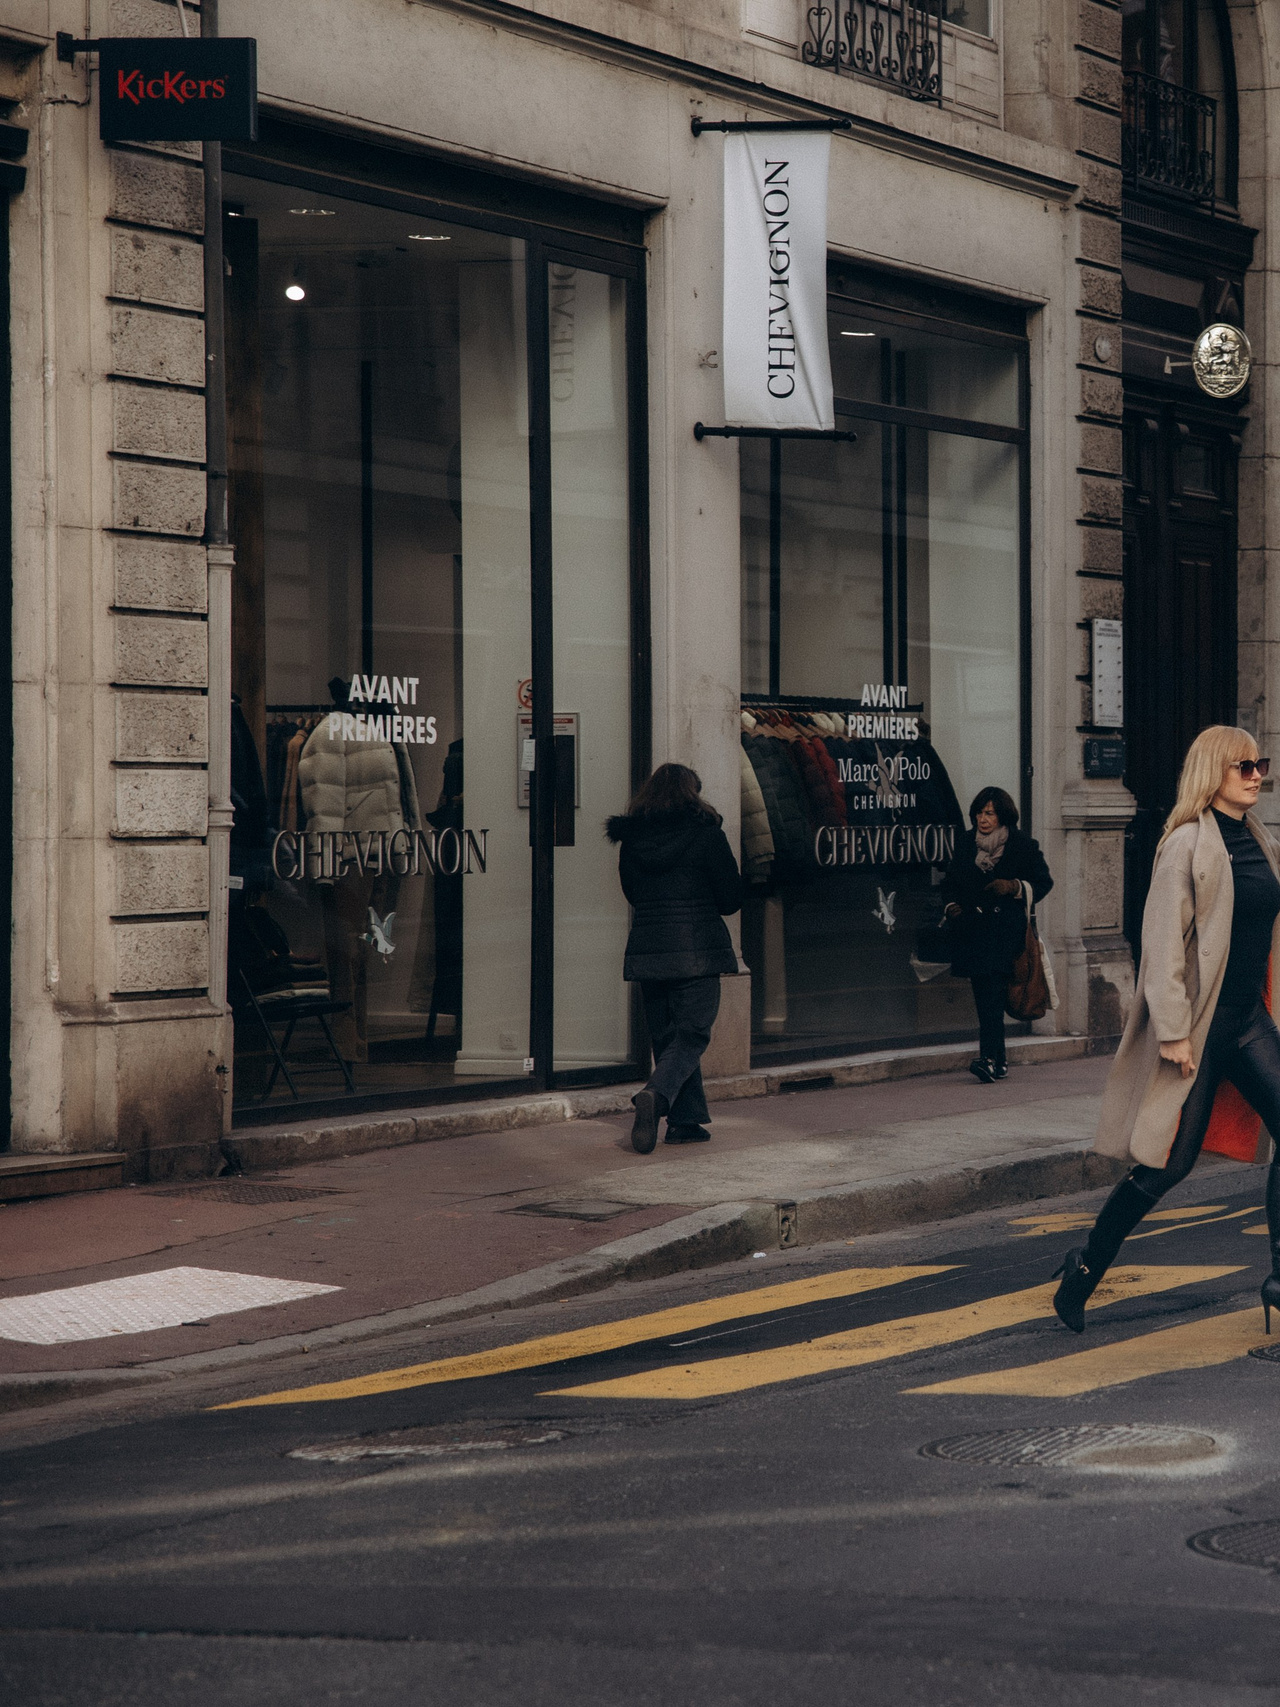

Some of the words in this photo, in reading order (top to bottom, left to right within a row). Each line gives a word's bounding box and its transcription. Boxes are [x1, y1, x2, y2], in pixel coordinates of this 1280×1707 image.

[763, 158, 796, 399] CHEVIGNON
[348, 673, 419, 705] AVANT
[860, 684, 907, 709] AVANT
[328, 705, 437, 744] PREMIÈRES
[848, 709, 919, 740] PREMIÈRES
[837, 758, 880, 783] Marc
[881, 756, 931, 781] O'Polo
[853, 793, 916, 810] CHEVIGNON
[272, 826, 489, 881] CHEVIGNON
[815, 823, 957, 867] CHEVIGNON
